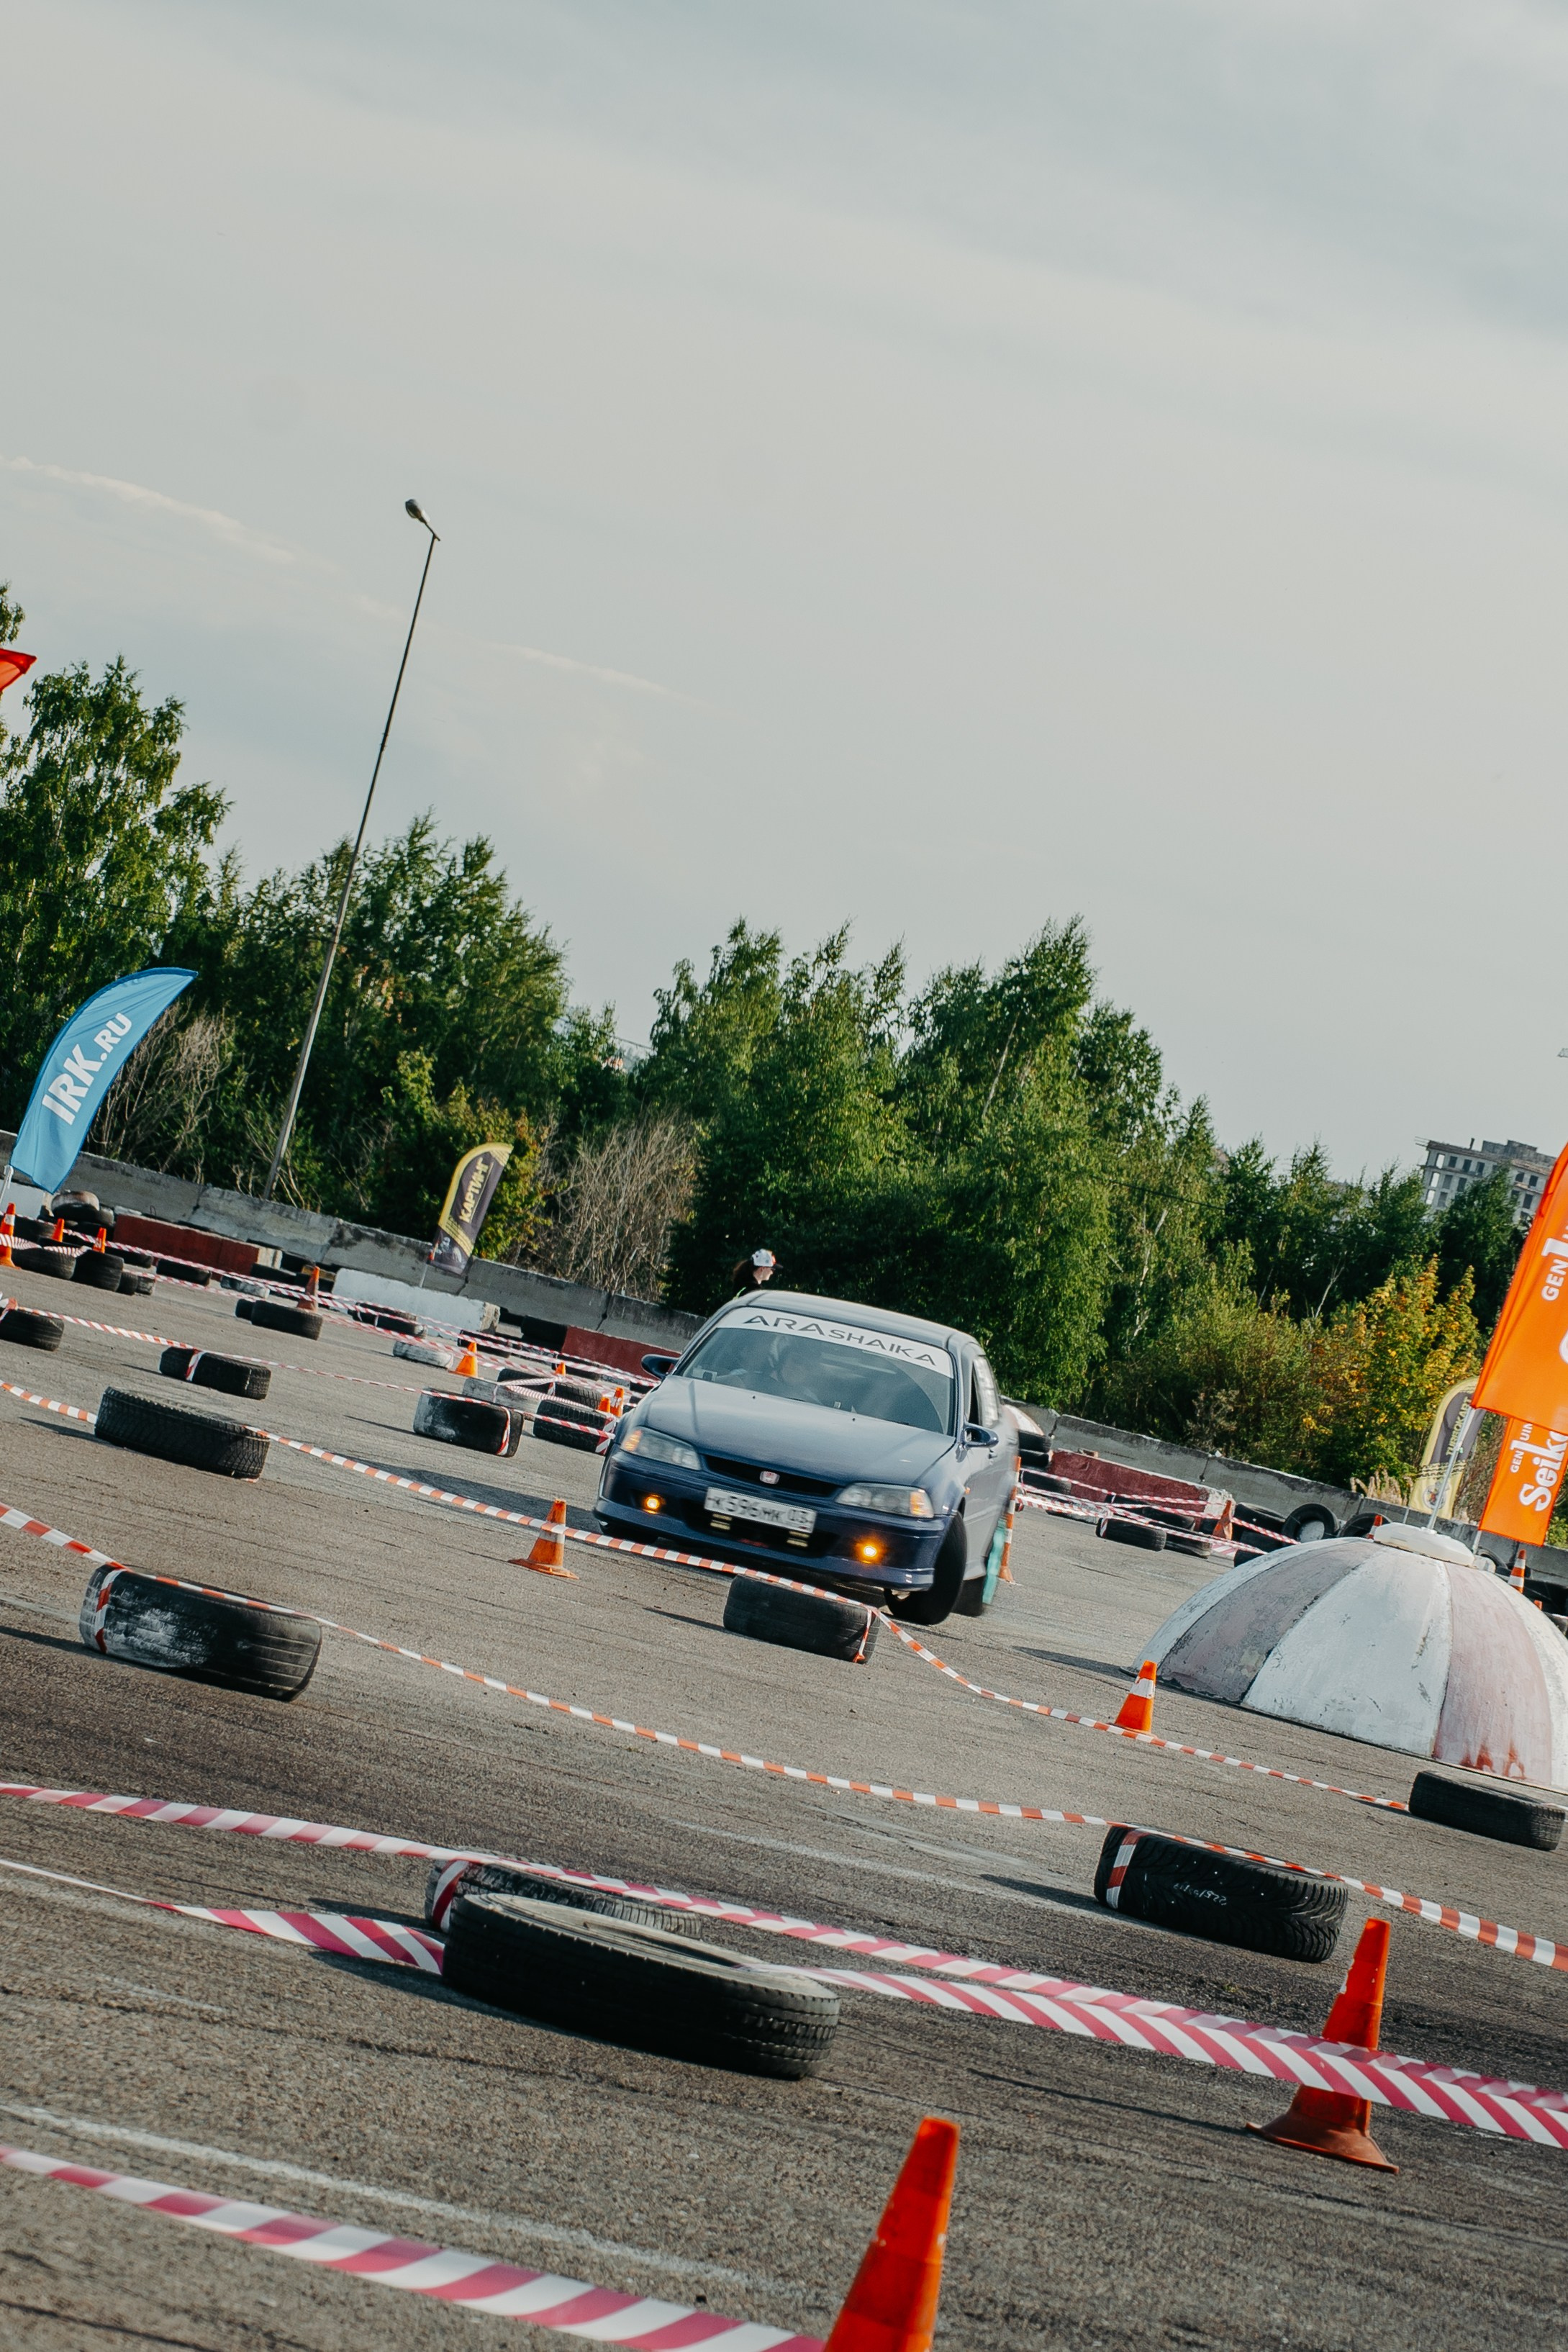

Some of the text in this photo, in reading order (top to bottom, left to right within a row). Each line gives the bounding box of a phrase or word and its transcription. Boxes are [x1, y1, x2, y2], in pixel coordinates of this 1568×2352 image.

[42, 1013, 132, 1125] IRK.RU
[458, 1157, 490, 1223] КАРТИНГ
[743, 1315, 936, 1366] ARASHAIKA
